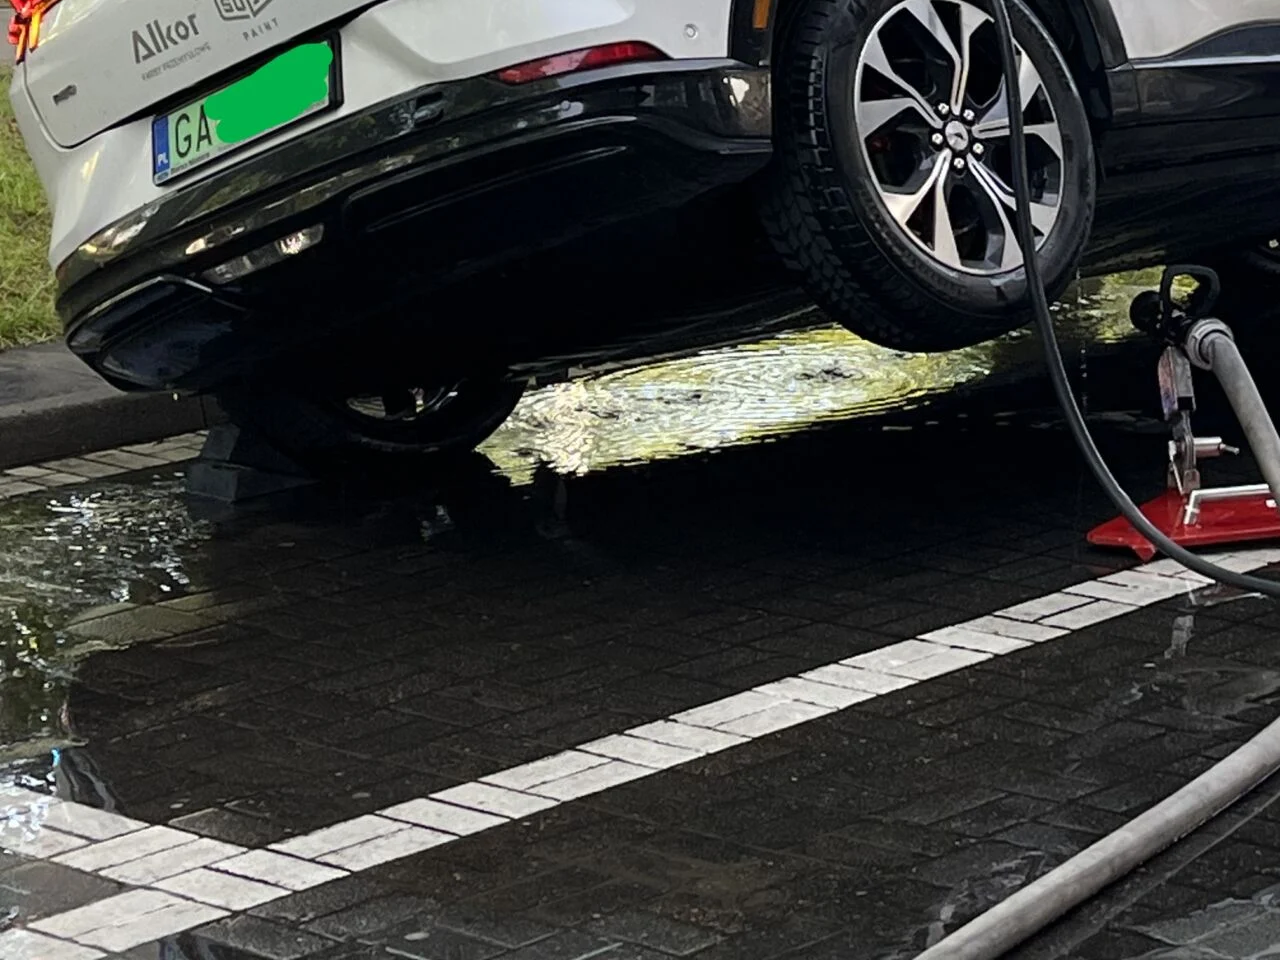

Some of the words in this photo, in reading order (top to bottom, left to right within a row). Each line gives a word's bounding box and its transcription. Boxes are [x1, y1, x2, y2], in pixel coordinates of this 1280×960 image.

[131, 14, 199, 64] Alkor
[242, 17, 279, 41] PAINT
[157, 152, 169, 167] PL
